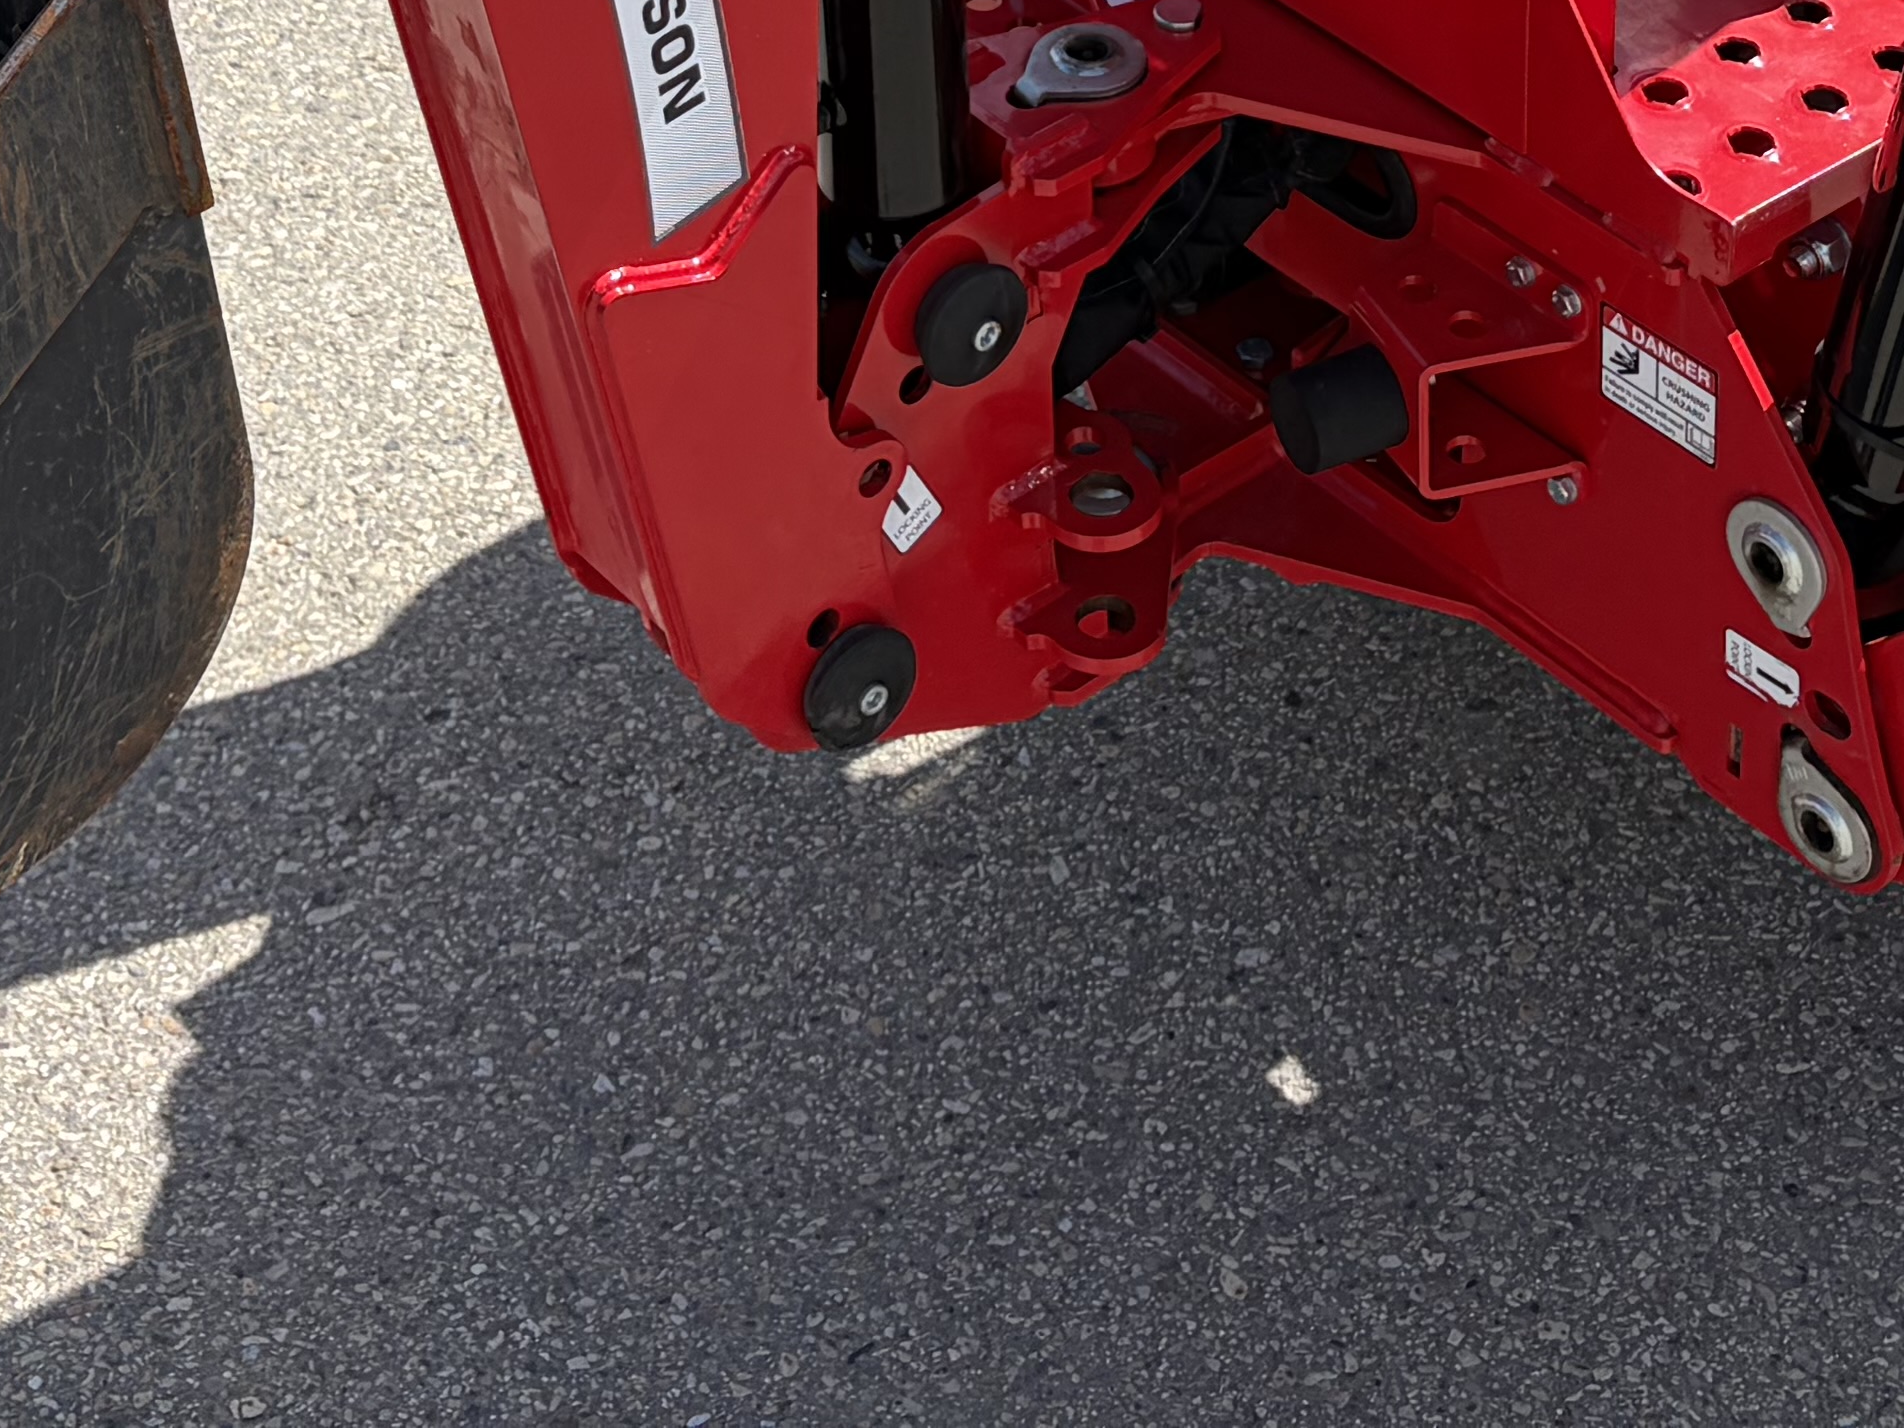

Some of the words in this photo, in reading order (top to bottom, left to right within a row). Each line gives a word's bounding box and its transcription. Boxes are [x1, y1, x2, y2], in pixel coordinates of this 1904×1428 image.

[1632, 325, 1712, 389] DANGER
[1661, 376, 1710, 413] CRUSHING
[1666, 391, 1705, 423] HAZARD
[894, 498, 932, 540] LOCKING
[905, 511, 931, 541] POINT
